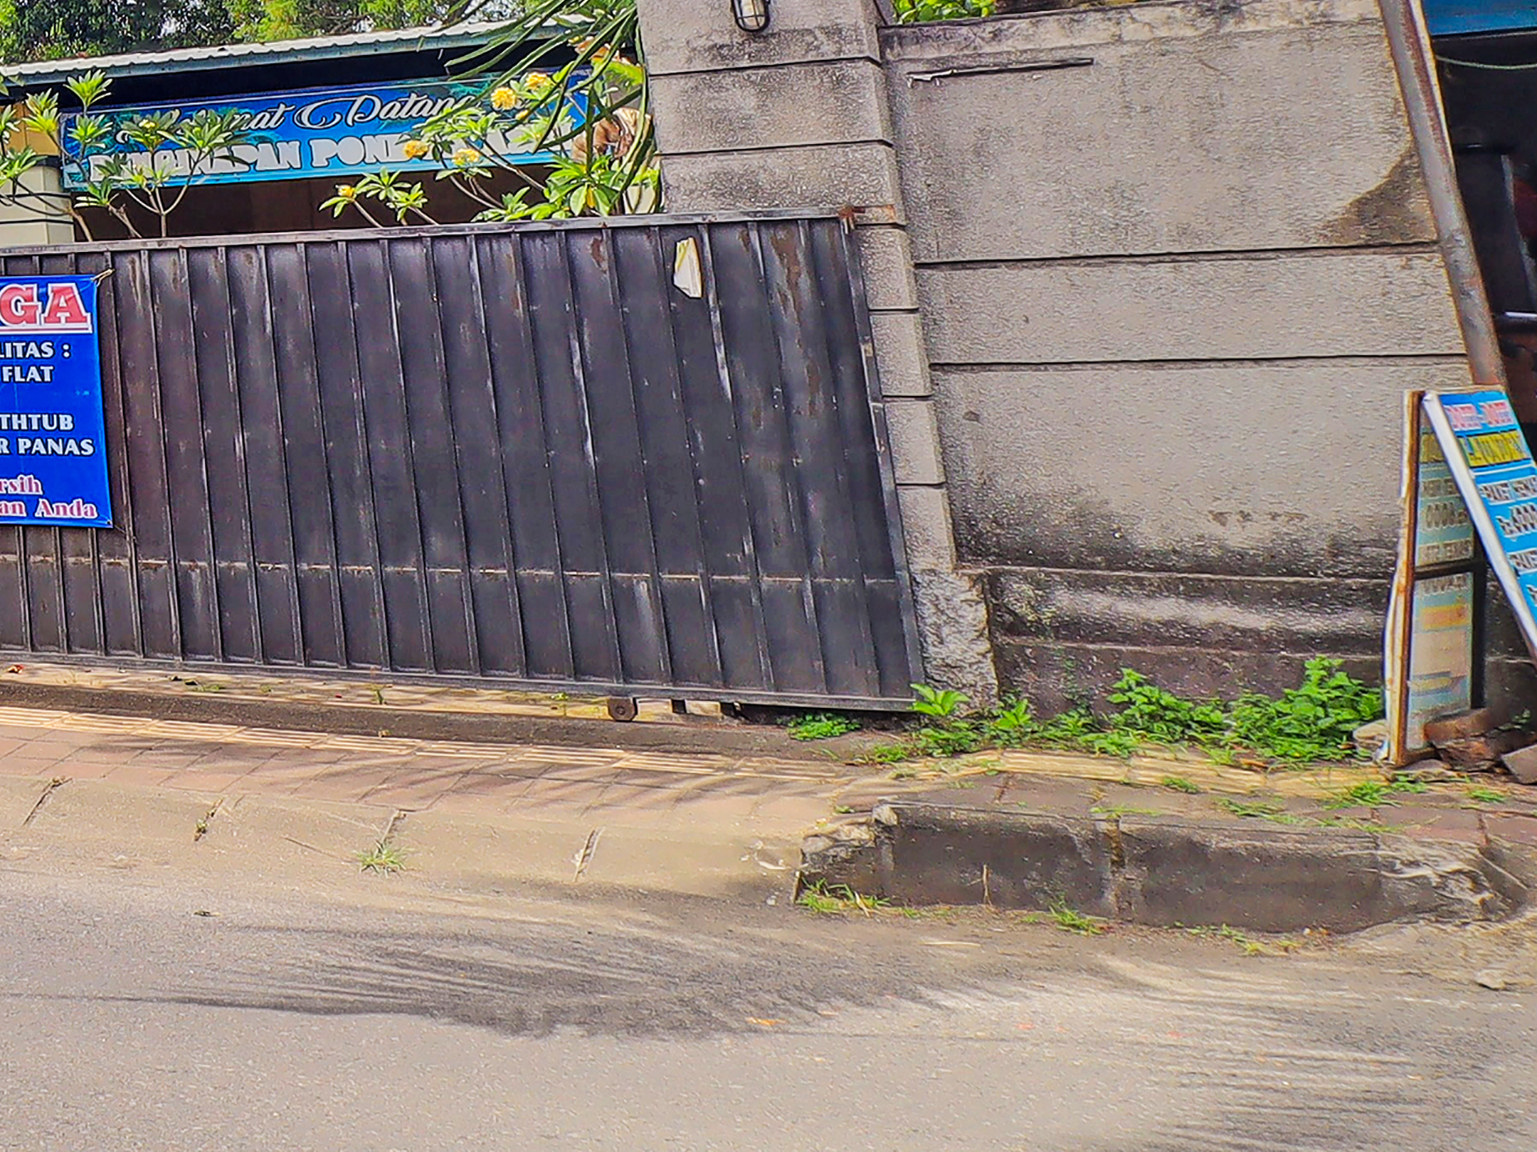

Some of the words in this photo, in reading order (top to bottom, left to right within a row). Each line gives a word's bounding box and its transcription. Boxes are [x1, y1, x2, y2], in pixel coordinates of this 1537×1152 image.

[2, 365, 54, 383] FLAT
[18, 437, 95, 456] PANAS
[34, 497, 98, 519] Anda
